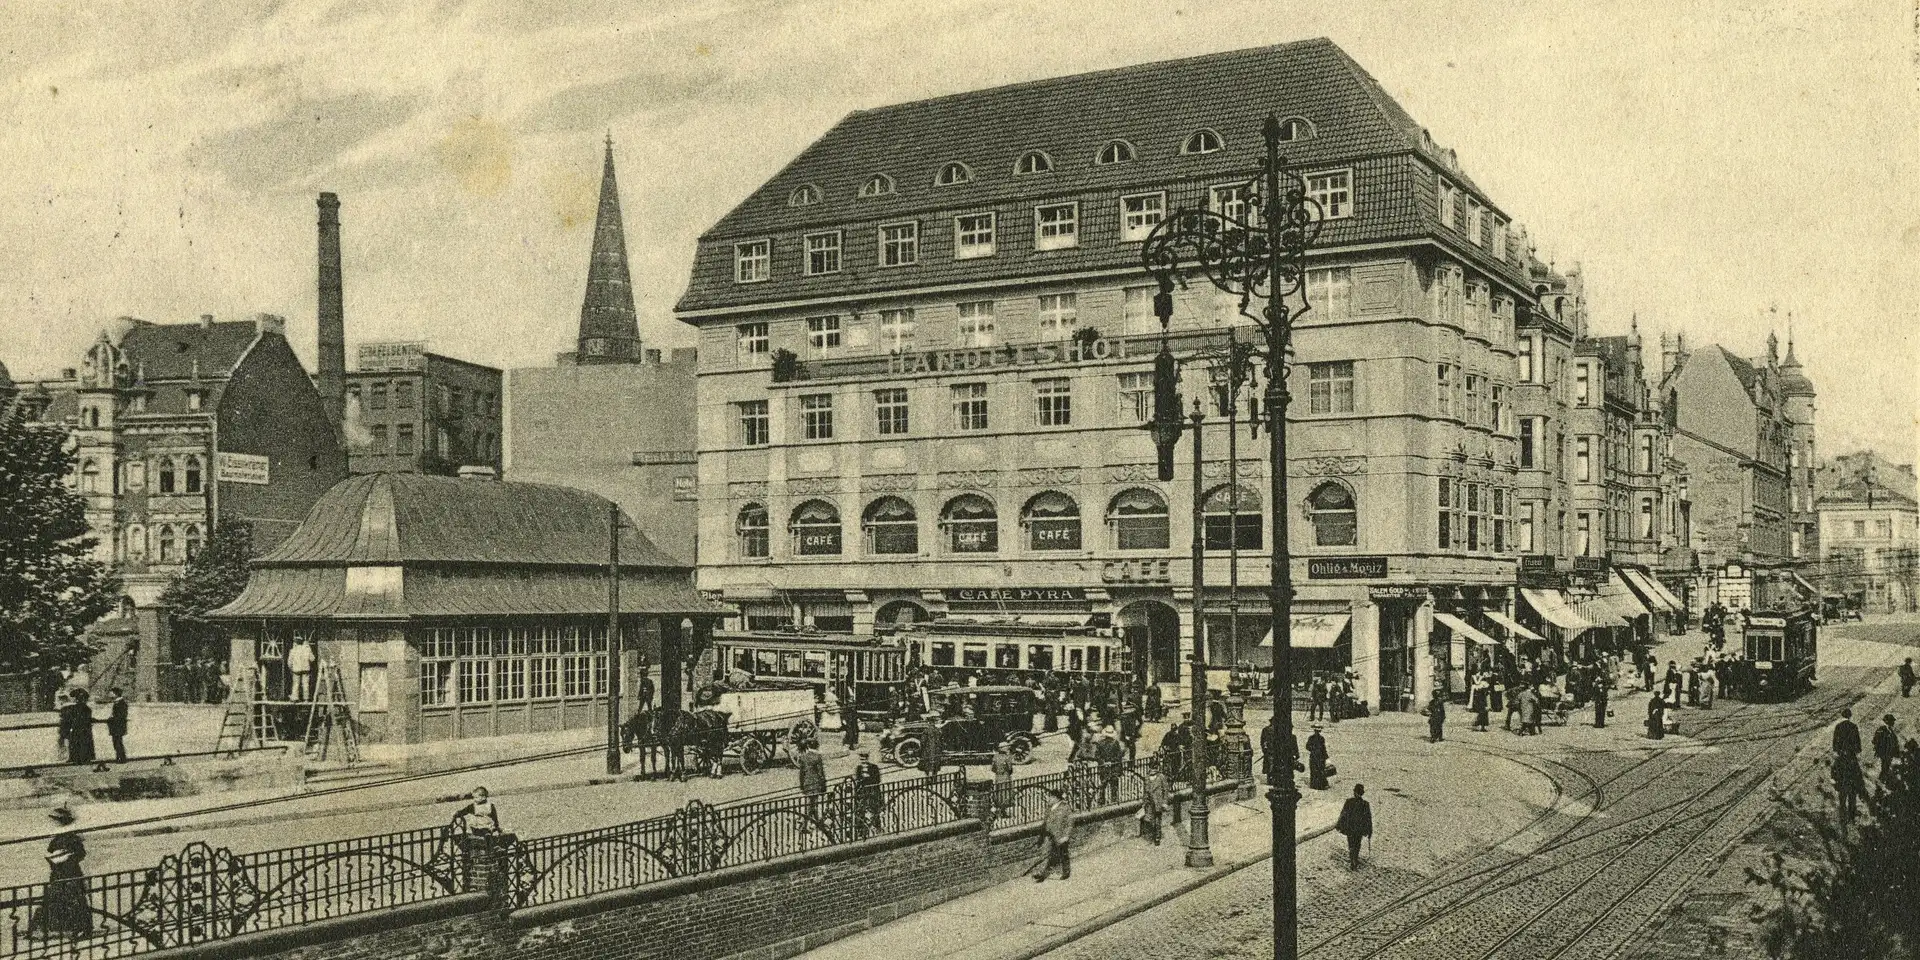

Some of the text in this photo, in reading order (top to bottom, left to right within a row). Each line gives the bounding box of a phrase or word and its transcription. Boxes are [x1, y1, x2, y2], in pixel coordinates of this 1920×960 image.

[806, 532, 832, 546] CAFÉ
[959, 530, 988, 543] CAFÉ
[1038, 530, 1070, 541] CAFÉ
[1020, 589, 1074, 600] PYRA
